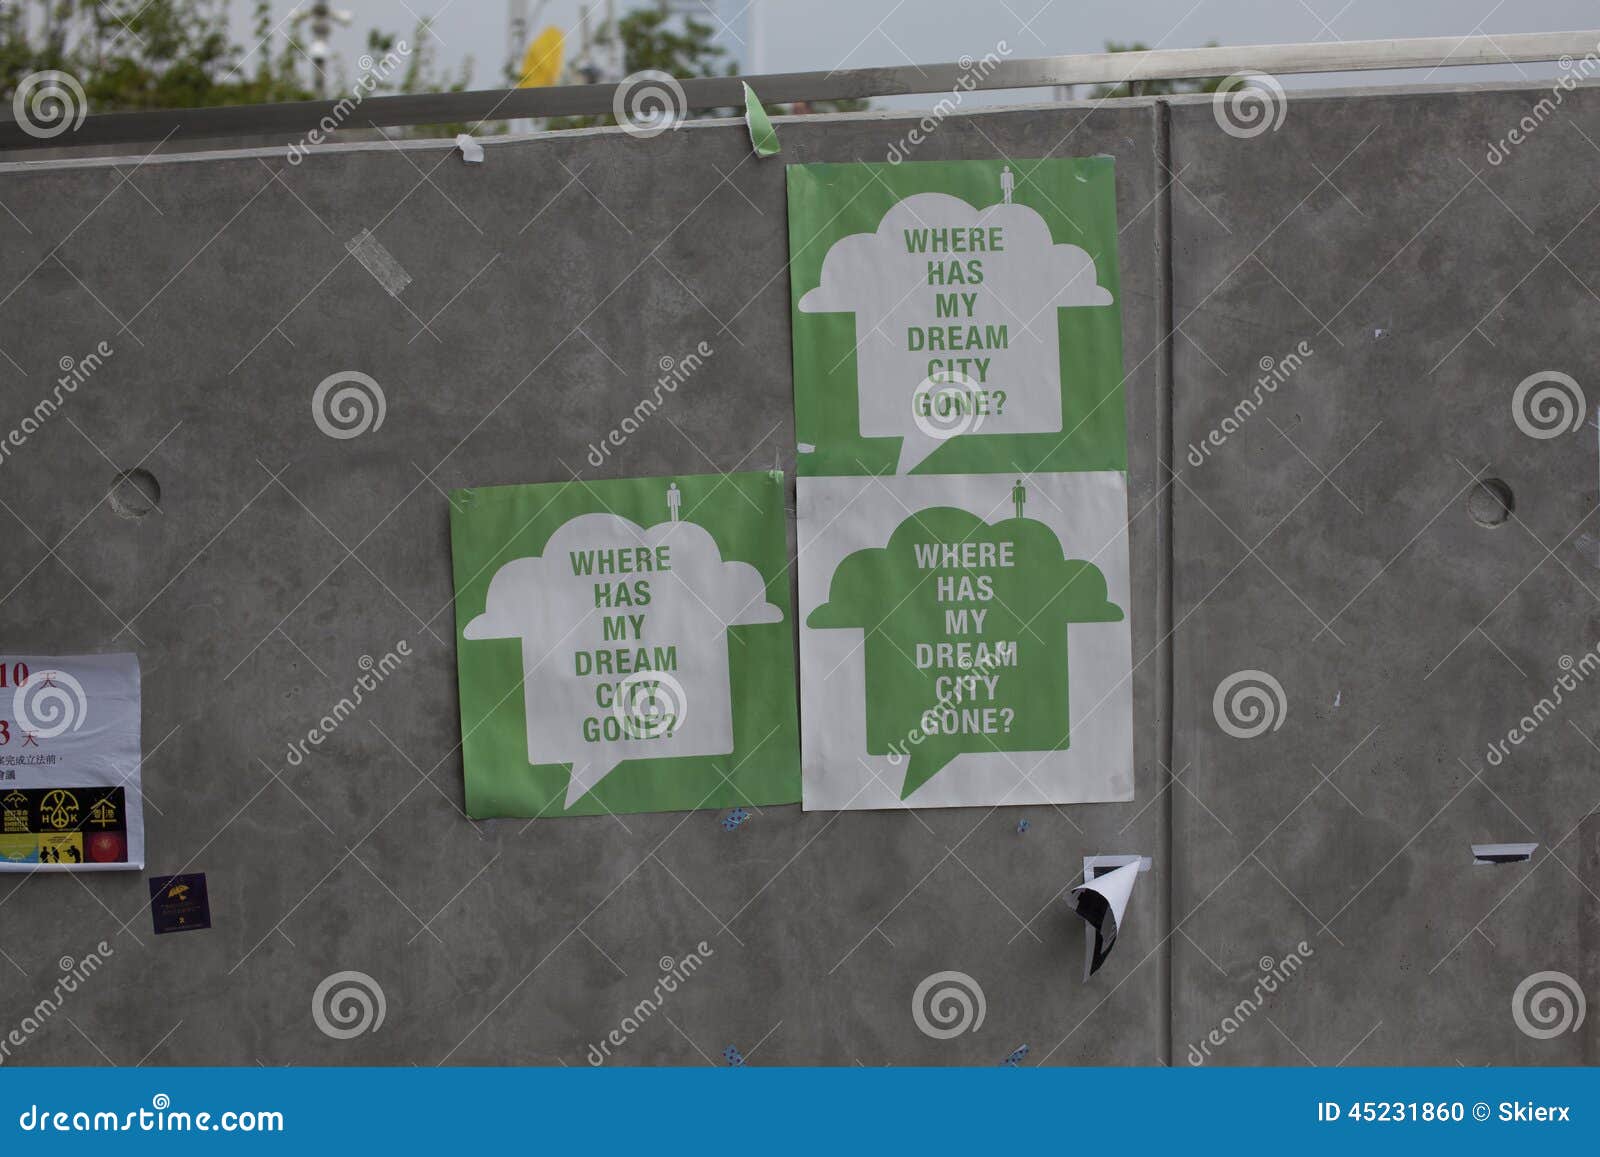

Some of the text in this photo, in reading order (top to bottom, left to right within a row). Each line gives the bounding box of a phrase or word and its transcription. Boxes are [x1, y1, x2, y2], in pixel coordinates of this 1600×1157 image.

[904, 227, 1004, 253] WHERE
[927, 259, 984, 286] HAS
[935, 292, 978, 318] MY
[907, 324, 1009, 352] DREAM
[927, 357, 991, 384] CITY
[914, 390, 1007, 417] GONE?
[569, 546, 672, 576] WHERE
[913, 542, 1015, 569] WHERE
[593, 580, 652, 609] HAS
[936, 575, 994, 602] HAS
[602, 614, 645, 641] MY
[945, 608, 988, 635] MY
[574, 646, 678, 676] DREAM
[915, 641, 1018, 670] DREAM
[595, 680, 660, 709] CITY
[935, 675, 1000, 702] CITY
[582, 713, 678, 743] GONE?
[920, 707, 1015, 735] GONE?
